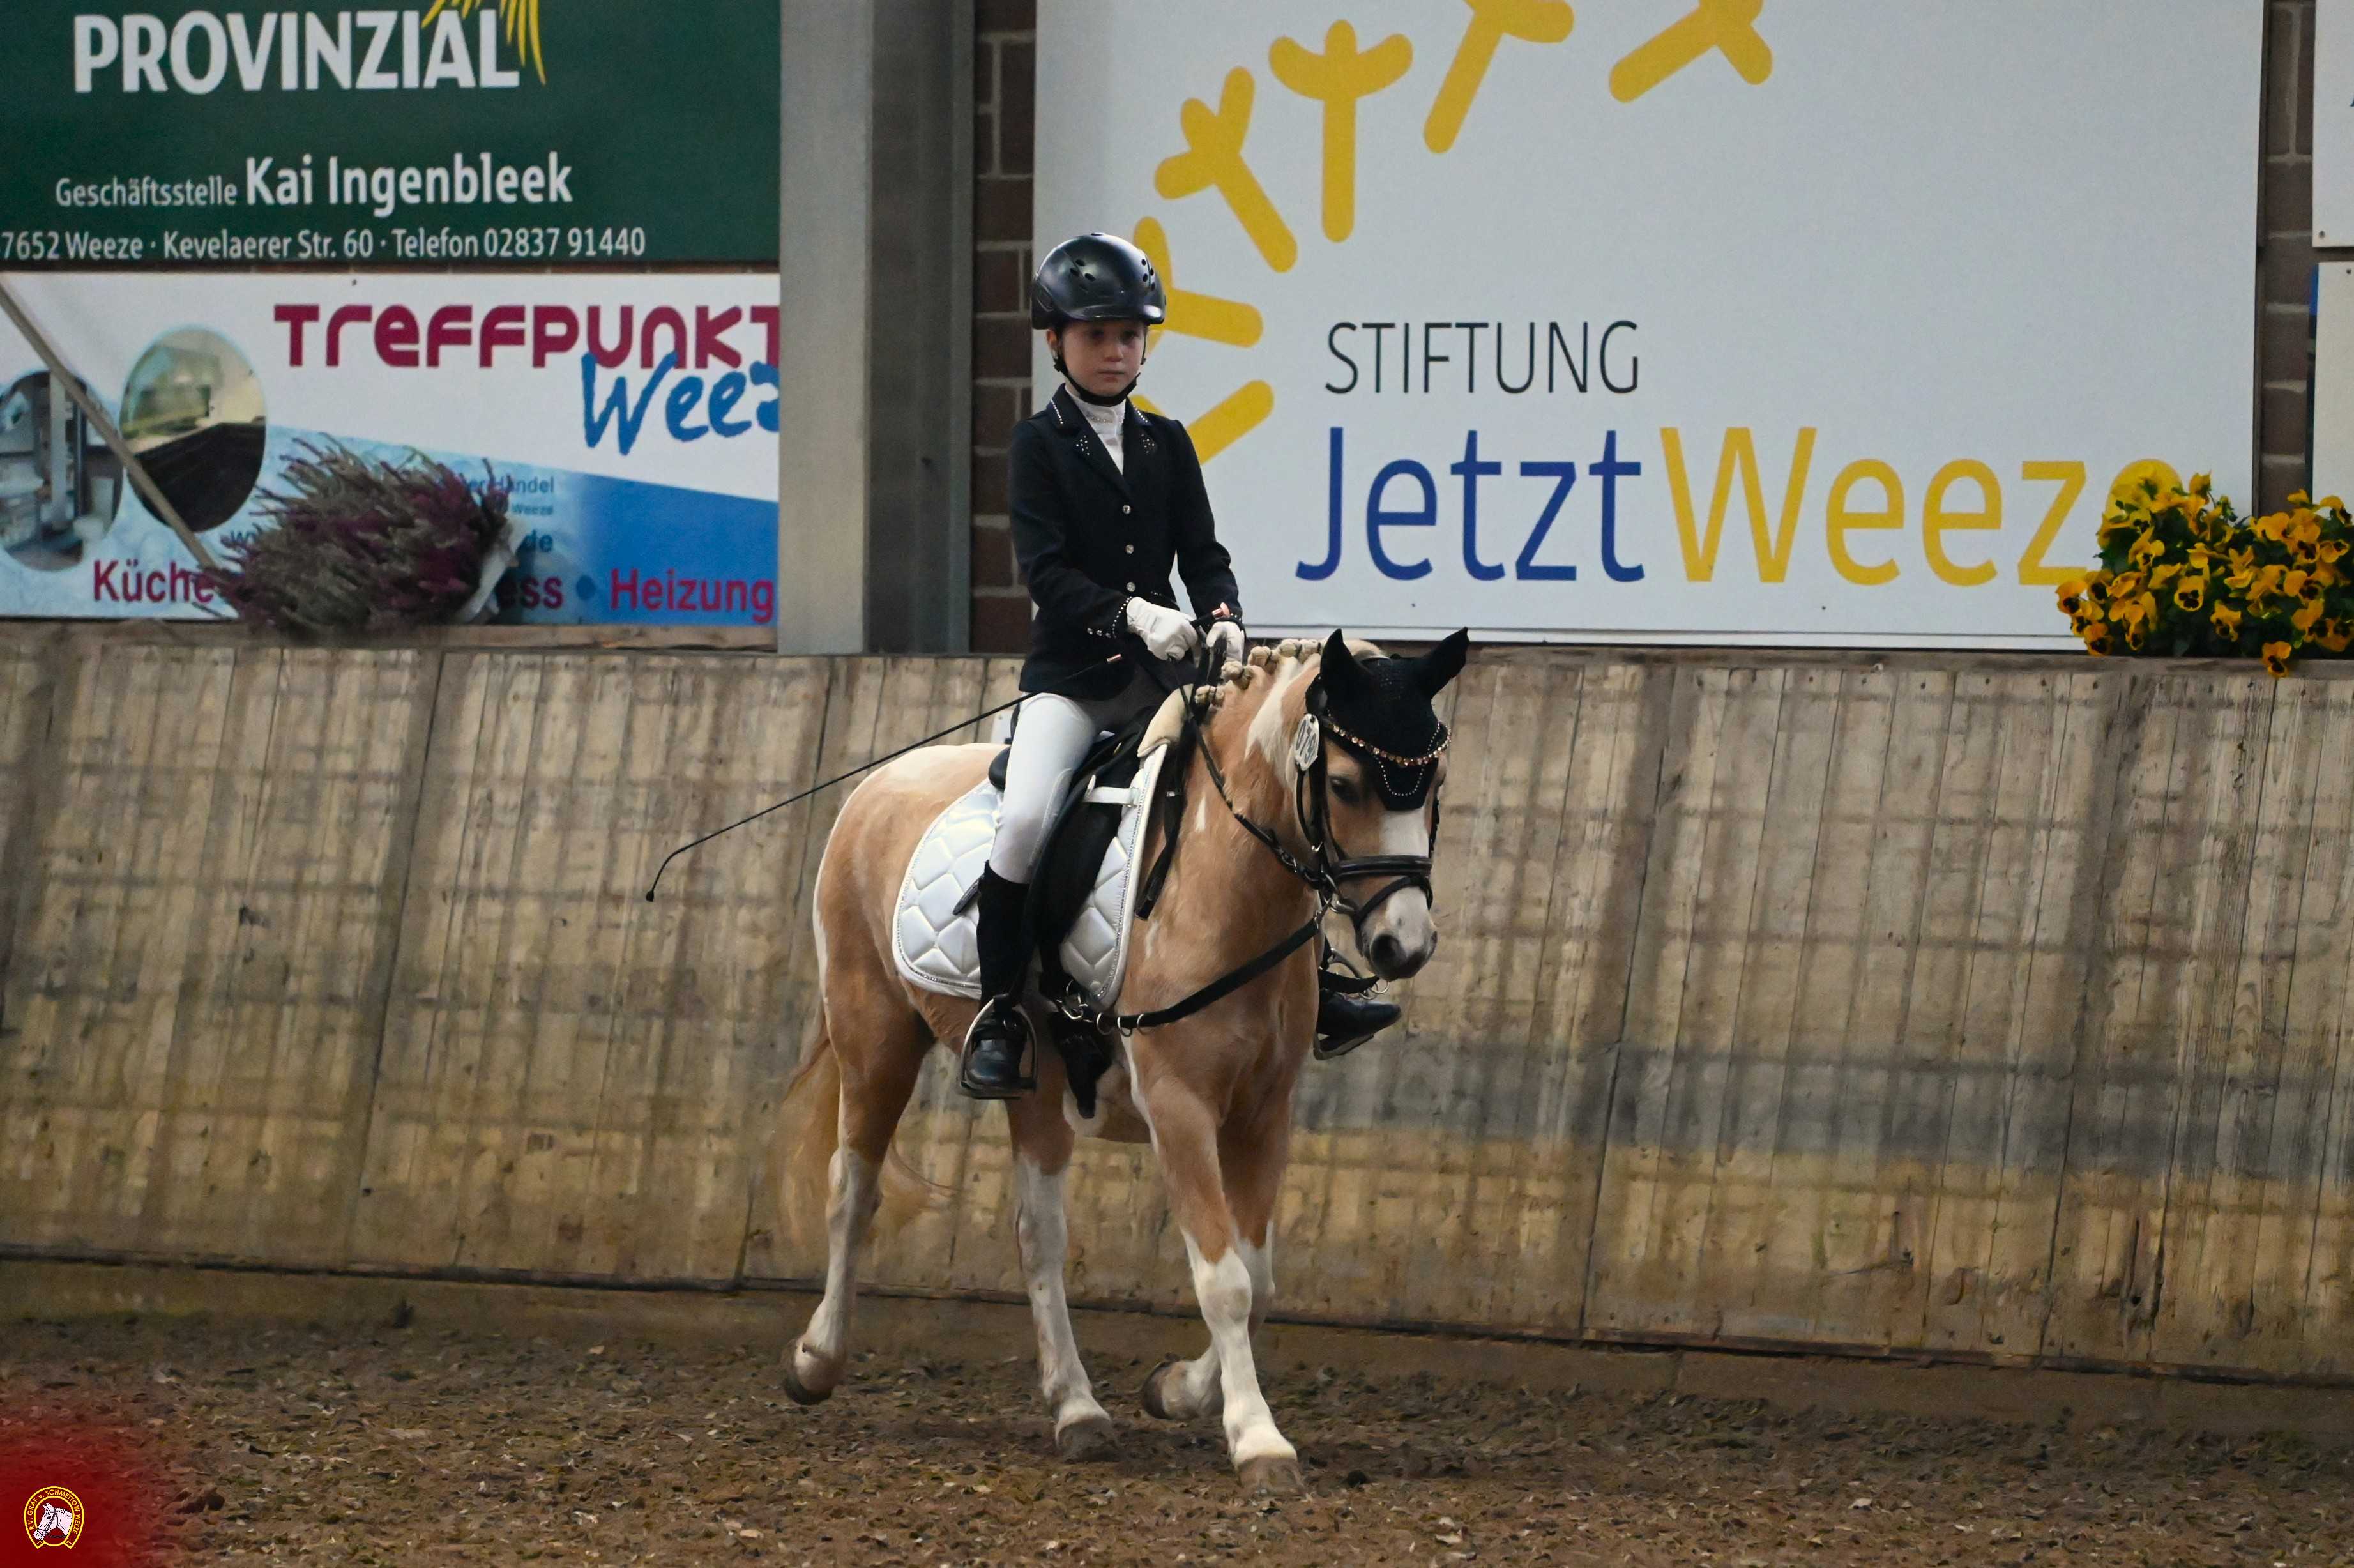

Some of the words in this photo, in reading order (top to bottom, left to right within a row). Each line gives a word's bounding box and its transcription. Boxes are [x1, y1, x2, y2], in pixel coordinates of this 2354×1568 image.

[73, 9, 520, 95] PROVINZIAL
[56, 175, 238, 208] Geschäftsstelle
[246, 154, 312, 205] Kai
[328, 151, 573, 218] Ingenbleek
[1, 231, 61, 260] 7652
[65, 231, 144, 260] Weeze
[163, 228, 292, 260] Kevelaerer
[298, 228, 337, 259] Str.
[343, 228, 374, 258] 60
[391, 227, 478, 258] Telefon
[483, 227, 559, 257] 02837
[567, 226, 646, 256] 91440
[1325, 321, 1639, 395] STIFTUNG
[610, 567, 775, 625] Heizung
